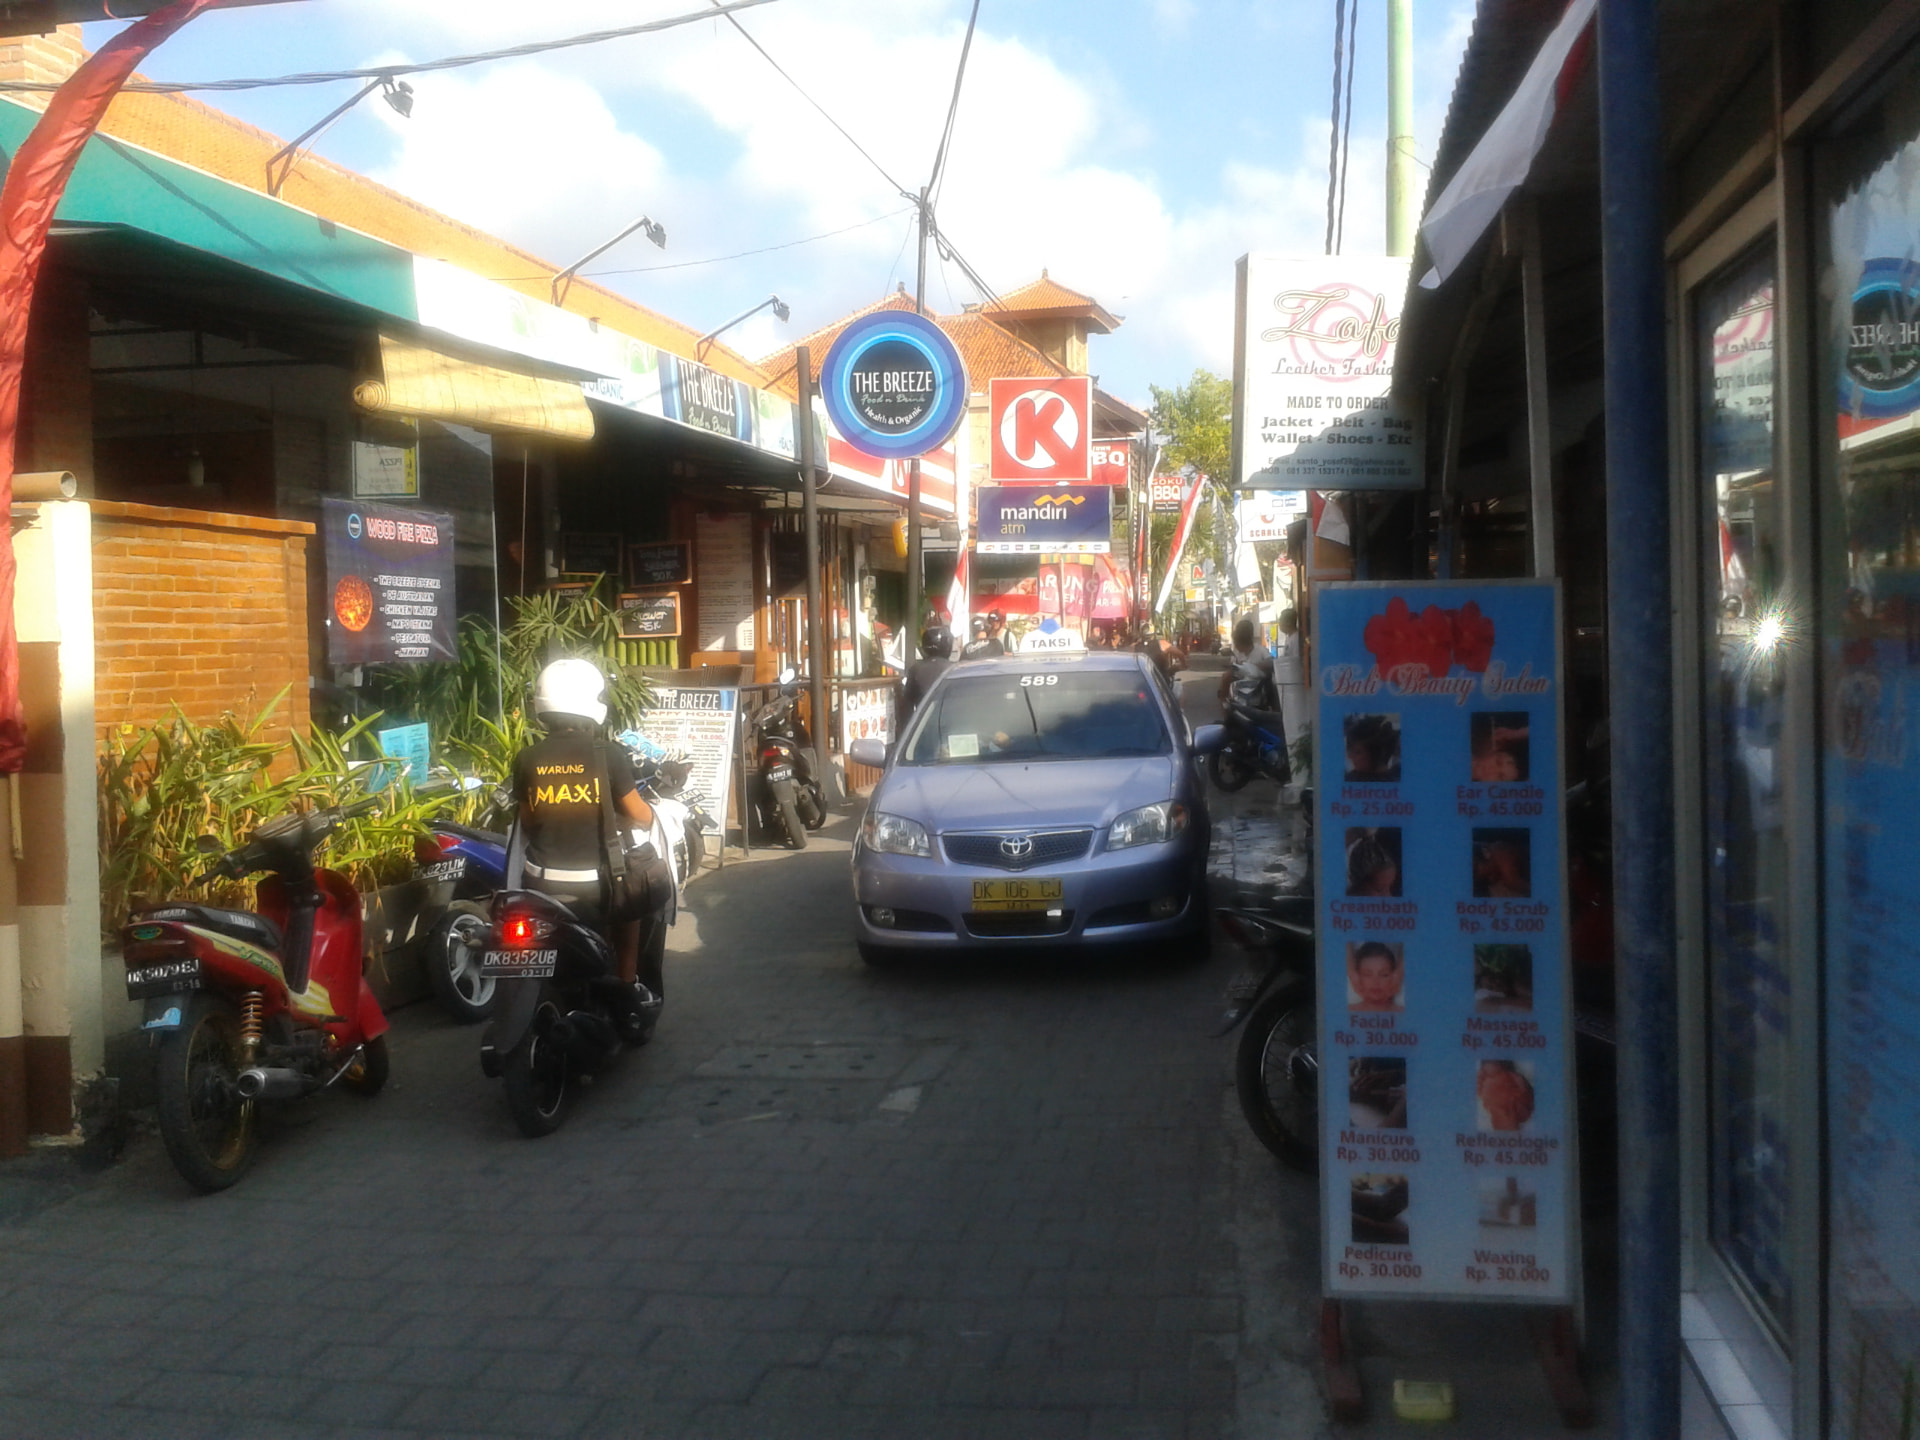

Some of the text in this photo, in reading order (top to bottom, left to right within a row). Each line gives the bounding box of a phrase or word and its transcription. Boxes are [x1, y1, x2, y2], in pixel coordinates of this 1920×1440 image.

[1271, 358, 1393, 376] Leather Fashio
[678, 359, 735, 417] THE BREEZE
[853, 371, 933, 393] THE BREEZE
[861, 394, 884, 405] Food
[896, 394, 926, 403] Drink
[1286, 396, 1389, 410] MADE TO ORDER
[864, 406, 887, 424] Health
[895, 406, 923, 425] Organic
[1261, 416, 1313, 429] Jacket
[1332, 417, 1365, 428] Belt
[1383, 417, 1413, 430] Bag
[1261, 433, 1313, 445] Wallet
[1327, 433, 1373, 445] Shoes
[1387, 434, 1412, 445] Etc
[1154, 485, 1181, 500] BBQ
[1000, 504, 1067, 520] mandiri
[366, 517, 396, 540] WOOD
[397, 521, 415, 542] FIRE
[415, 524, 438, 545] PIZZA
[1000, 522, 1026, 534] atm
[379, 575, 391, 586] THE
[392, 576, 416, 588] BREEZE
[385, 604, 412, 615] CHICKEN
[1030, 638, 1071, 649] TAKSI
[1020, 675, 1058, 687] 589
[1322, 660, 1548, 706] Bali Beauty Salon
[679, 693, 719, 710] BREEZE
[536, 764, 585, 776] WARUNG
[1341, 786, 1399, 799] Haircut
[1456, 786, 1545, 799] Ear Candle
[1330, 802, 1414, 816] Rp. 25.000
[1457, 802, 1543, 817] Rp. 45.000
[973, 881, 993, 899] DK
[1004, 881, 1029, 898] 106
[153, 908, 187, 920] YAMAHA
[1330, 901, 1419, 914] Creambath
[1456, 901, 1549, 918] Body Scrub
[1332, 916, 1416, 930] Rp. 30.000
[1459, 918, 1545, 933] Rp. 45.000
[1350, 1015, 1394, 1029] Facial
[1466, 1017, 1538, 1037] Massage
[1335, 1031, 1418, 1046] Rp. 30.000
[1462, 1034, 1546, 1049] Rp. 45.000
[1340, 1131, 1415, 1145] Manicure
[1455, 1133, 1559, 1149] Reflexologie
[1337, 1147, 1420, 1162] Rp. 30.000
[1464, 1151, 1547, 1166] Rp. 45.000
[1344, 1247, 1413, 1261] Pedicure
[1474, 1250, 1536, 1268] Waxing
[1339, 1263, 1421, 1278] Rp. 30.000
[1466, 1266, 1549, 1282] Rp. 30.000
